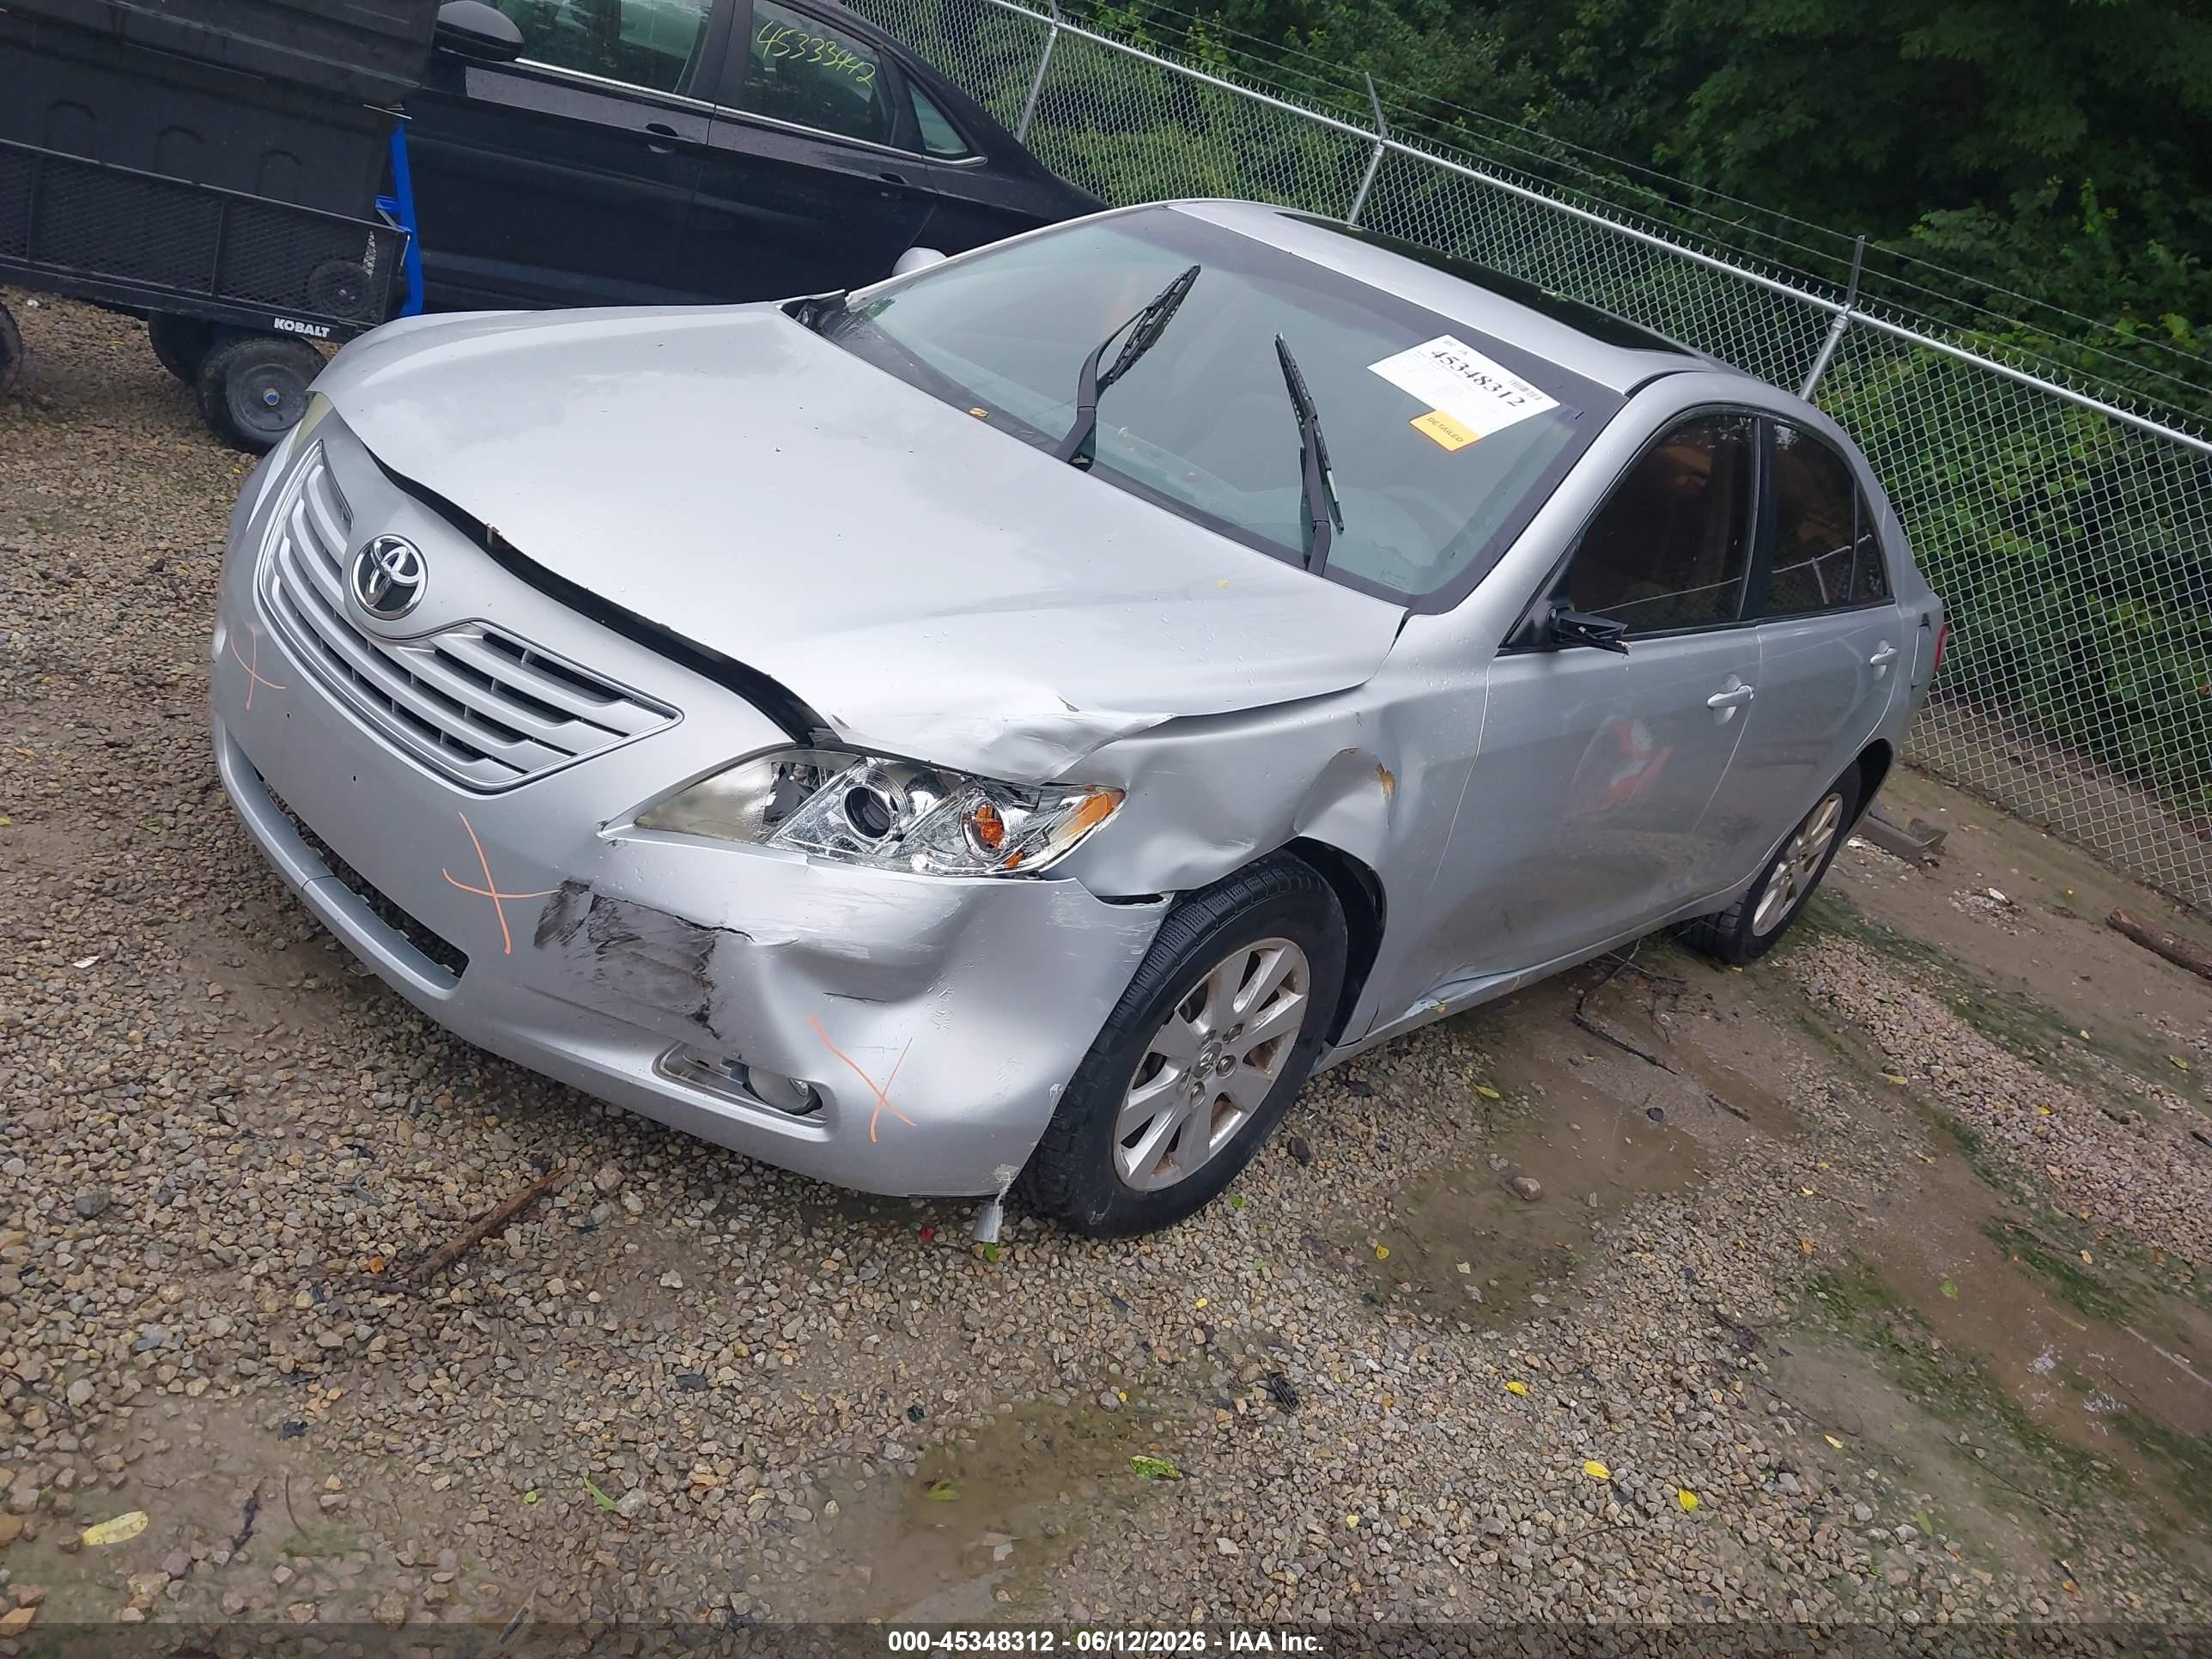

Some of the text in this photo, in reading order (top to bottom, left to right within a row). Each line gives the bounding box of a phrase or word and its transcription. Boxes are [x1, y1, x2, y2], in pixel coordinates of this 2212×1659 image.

[274, 317, 330, 337] KOBALT
[1431, 350, 1526, 407] 45348312
[1426, 416, 1464, 442] DETAILED
